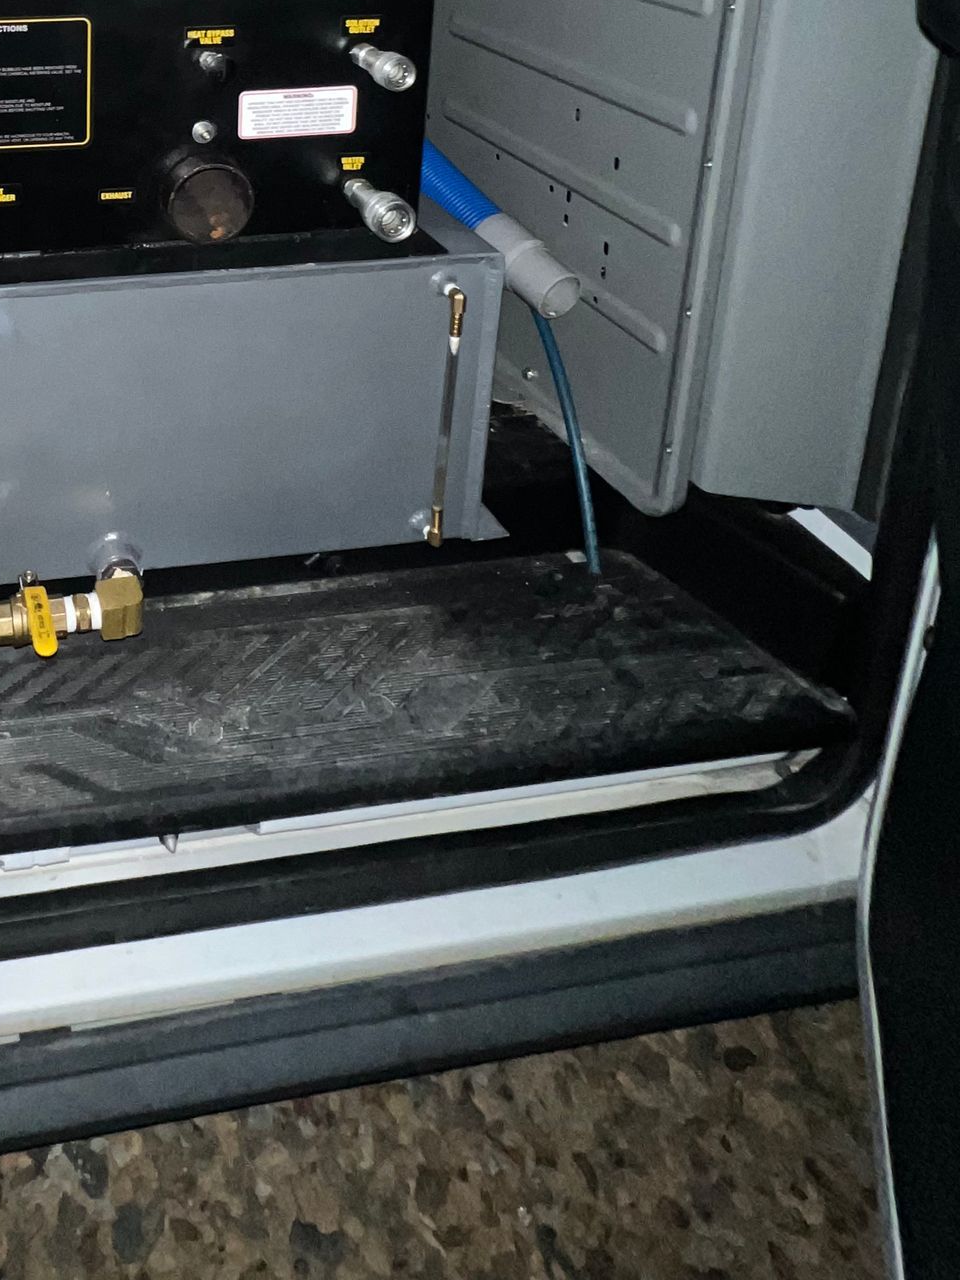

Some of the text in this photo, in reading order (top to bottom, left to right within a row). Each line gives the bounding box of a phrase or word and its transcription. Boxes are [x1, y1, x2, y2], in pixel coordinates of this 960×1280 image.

[345, 19, 381, 28] SOLUTION
[187, 29, 235, 38] HEAT BYPASS
[348, 25, 376, 34] OUTLET
[199, 36, 223, 45] VALVE
[341, 156, 365, 164] WATER
[100, 191, 133, 201] EXHAUST
